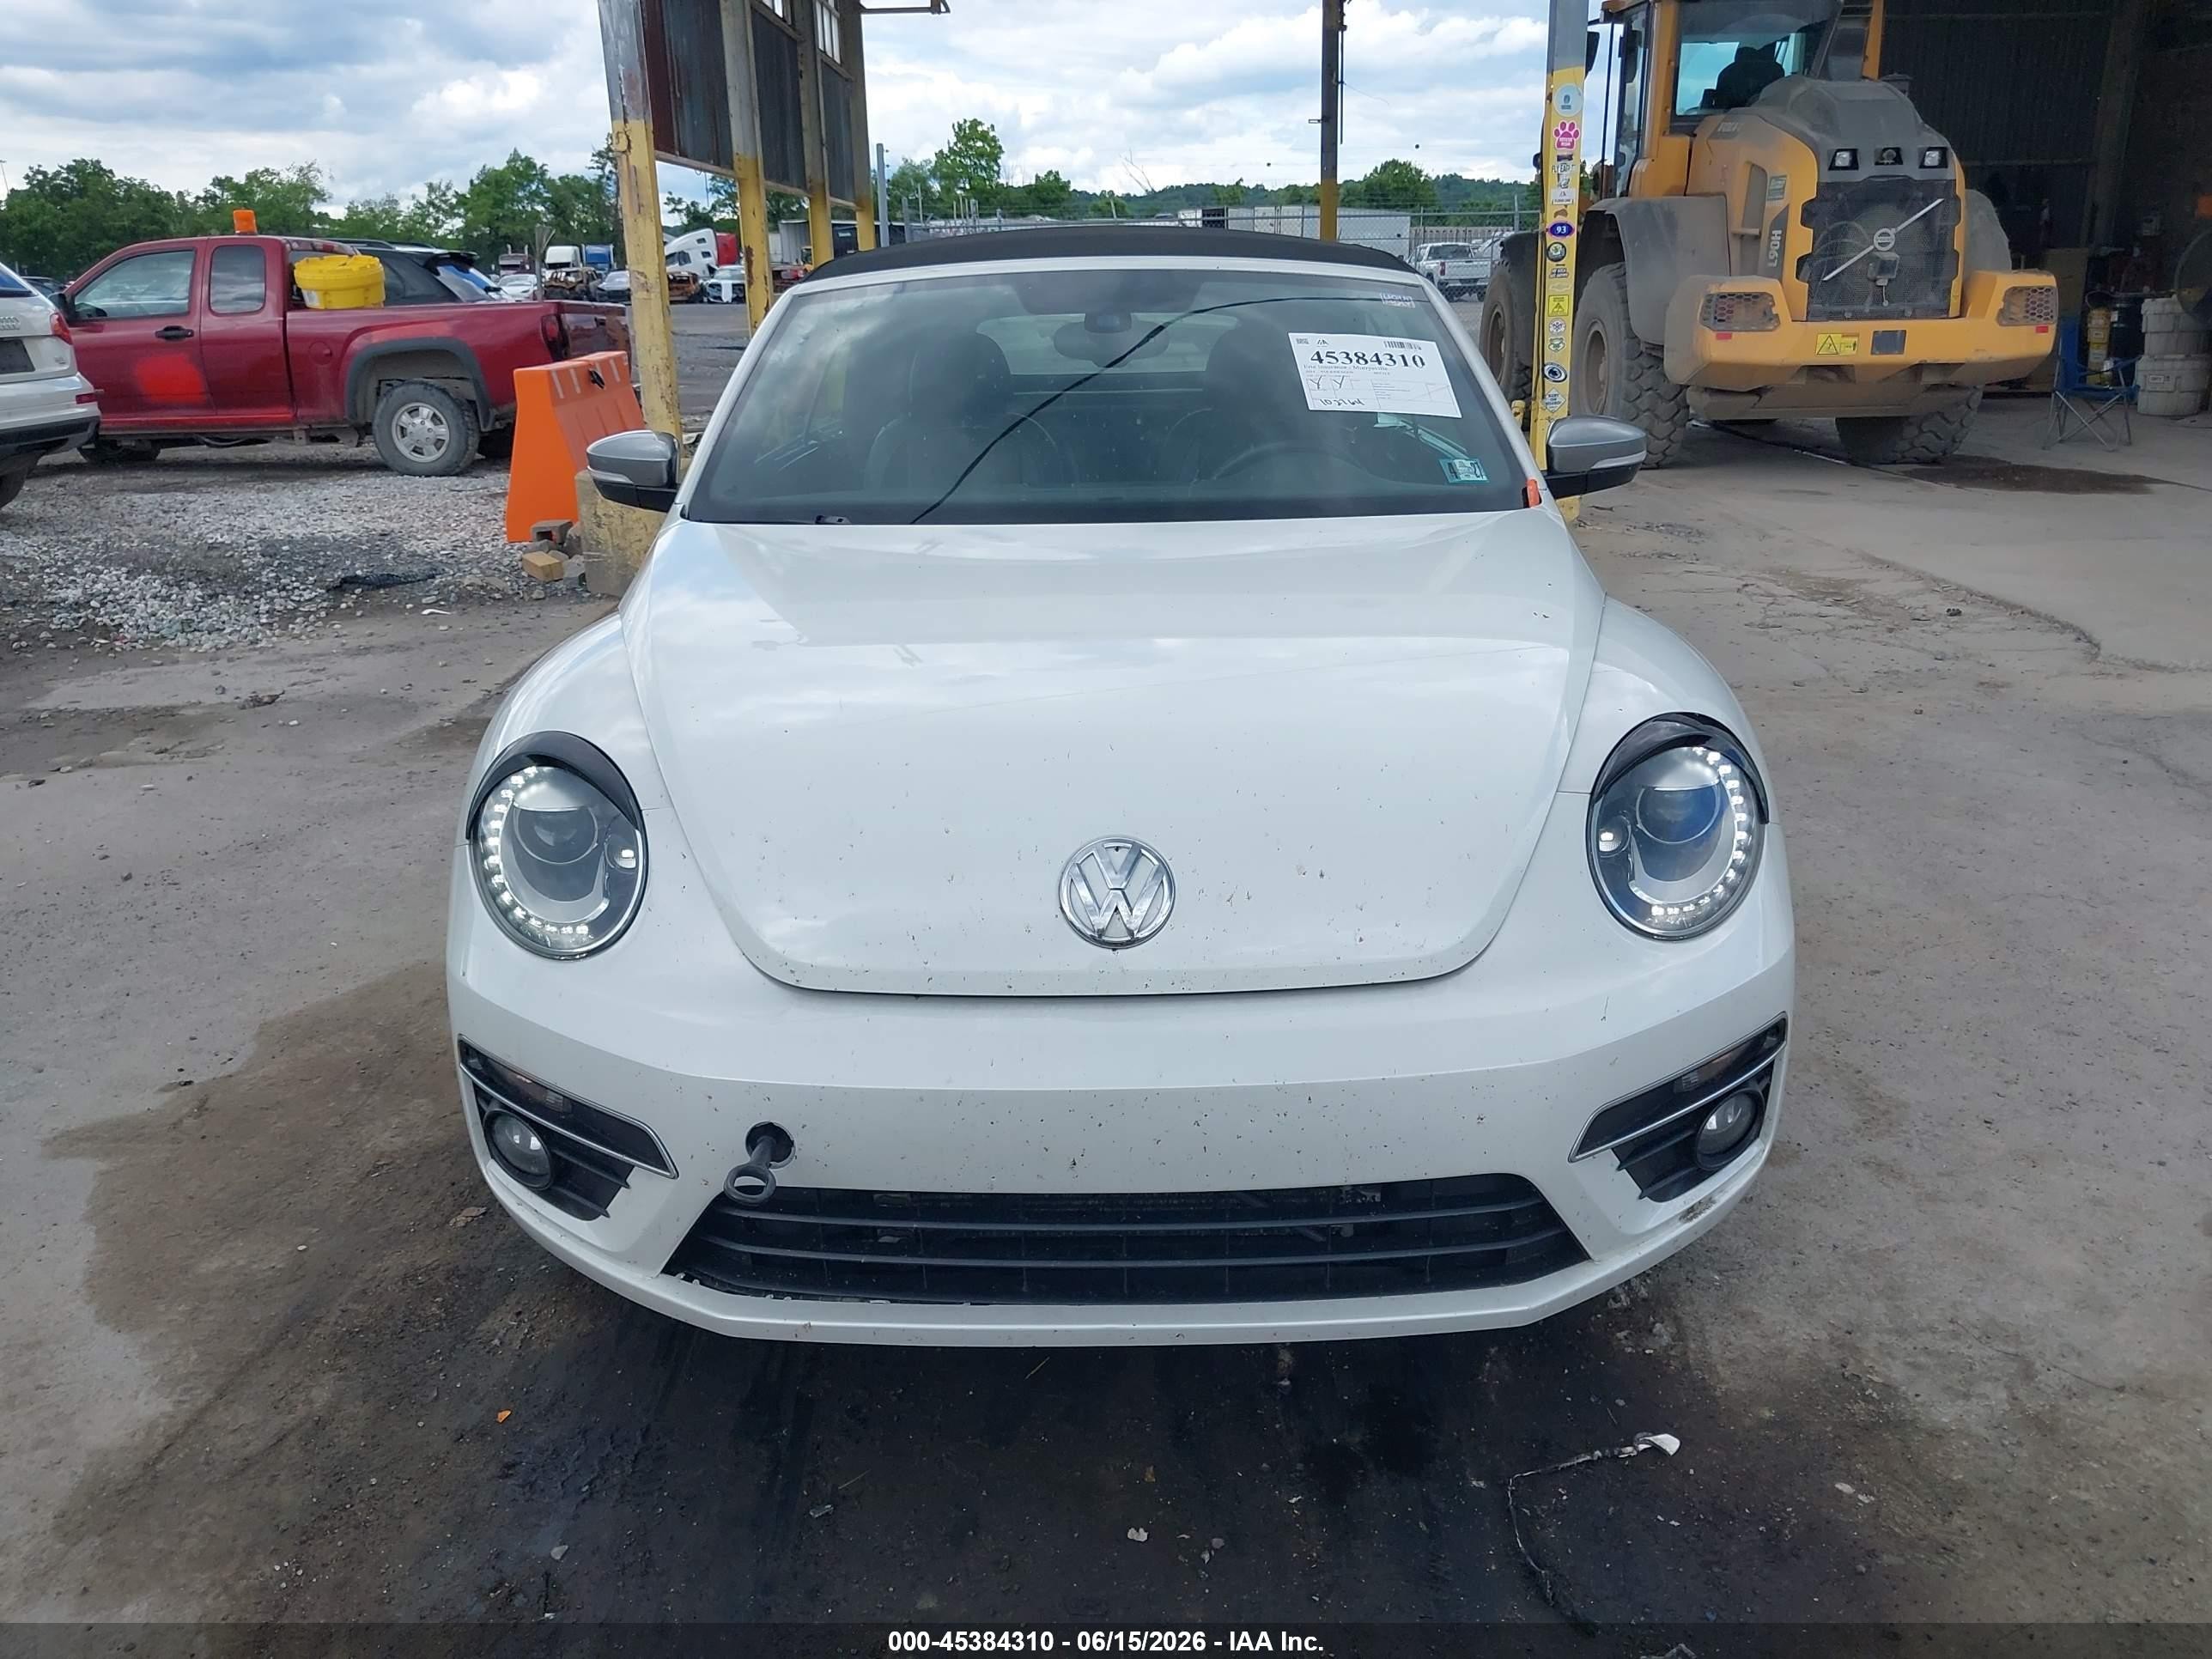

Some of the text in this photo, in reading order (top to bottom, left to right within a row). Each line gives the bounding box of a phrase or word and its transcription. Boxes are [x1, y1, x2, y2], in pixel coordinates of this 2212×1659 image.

[1556, 226, 1567, 234] 93
[1767, 229, 1783, 268] L90H
[1310, 350, 1425, 368] 45384310
[1448, 462, 1459, 480] 4
